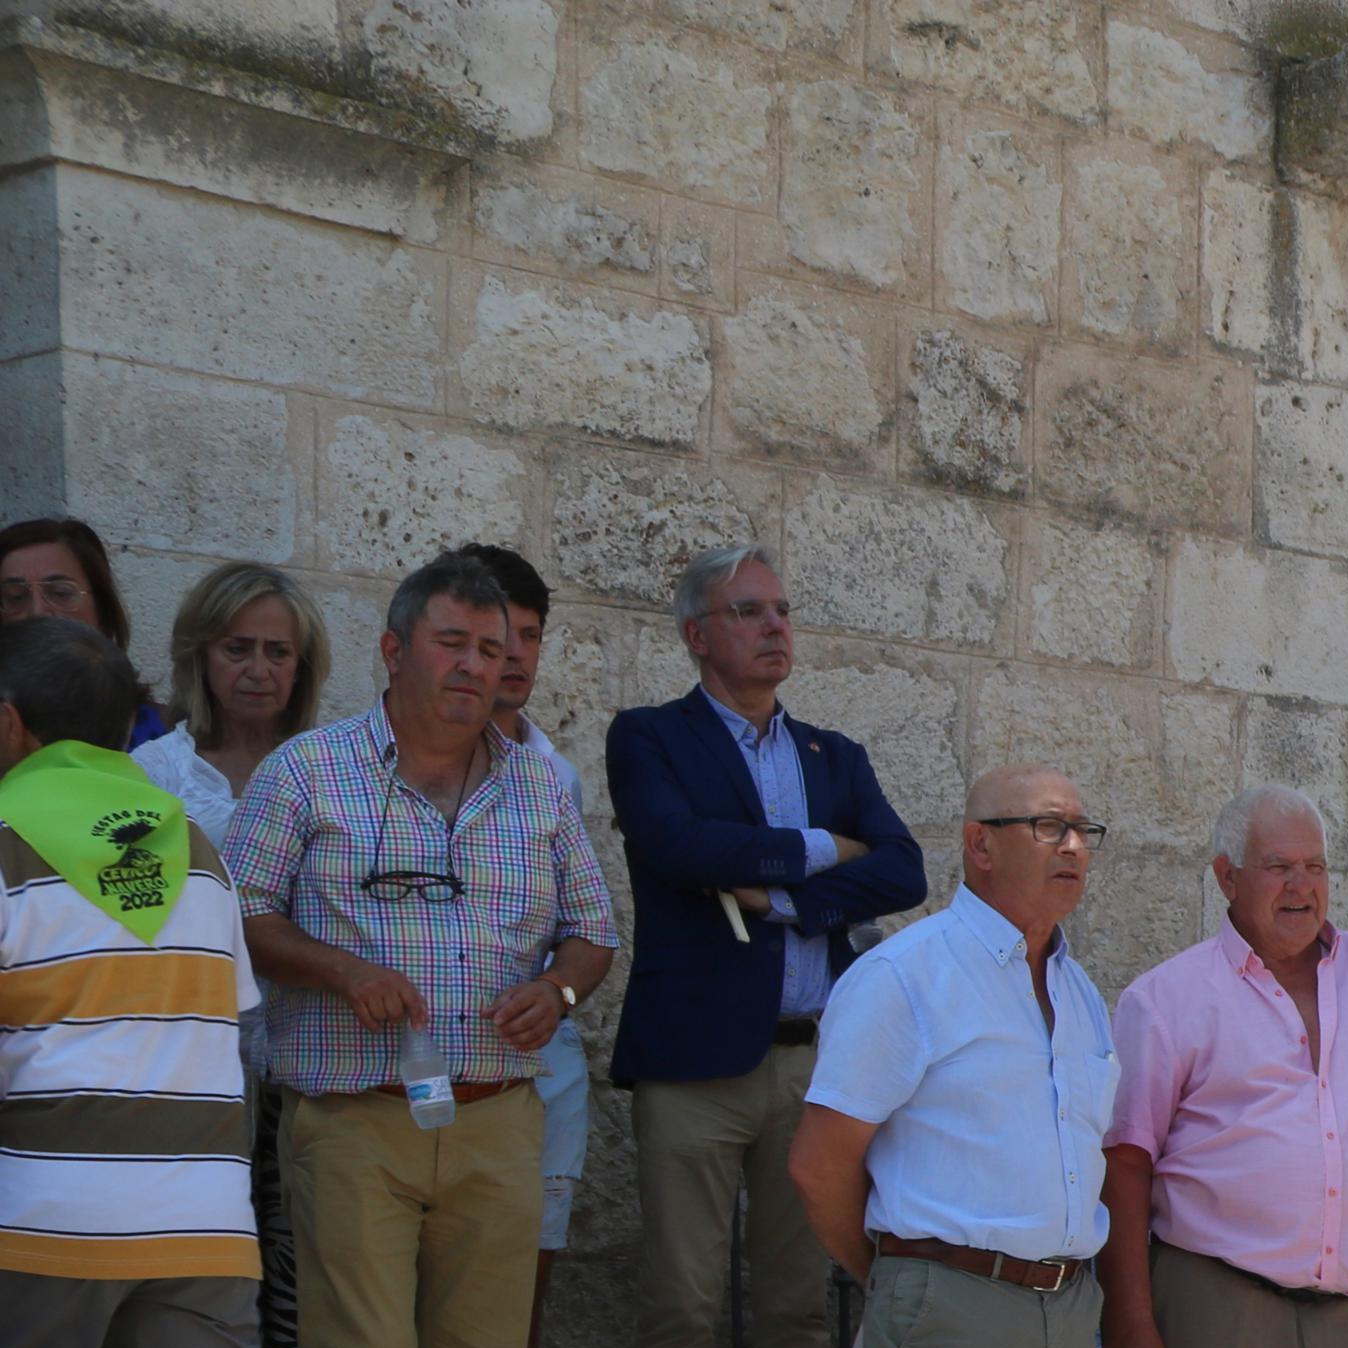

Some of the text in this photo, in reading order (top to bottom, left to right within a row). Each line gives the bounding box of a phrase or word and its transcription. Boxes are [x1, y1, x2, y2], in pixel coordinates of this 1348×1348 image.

[91, 810, 161, 837] FIESTAS DEL
[103, 876, 166, 896] NAVERO
[119, 891, 164, 911] 2022
